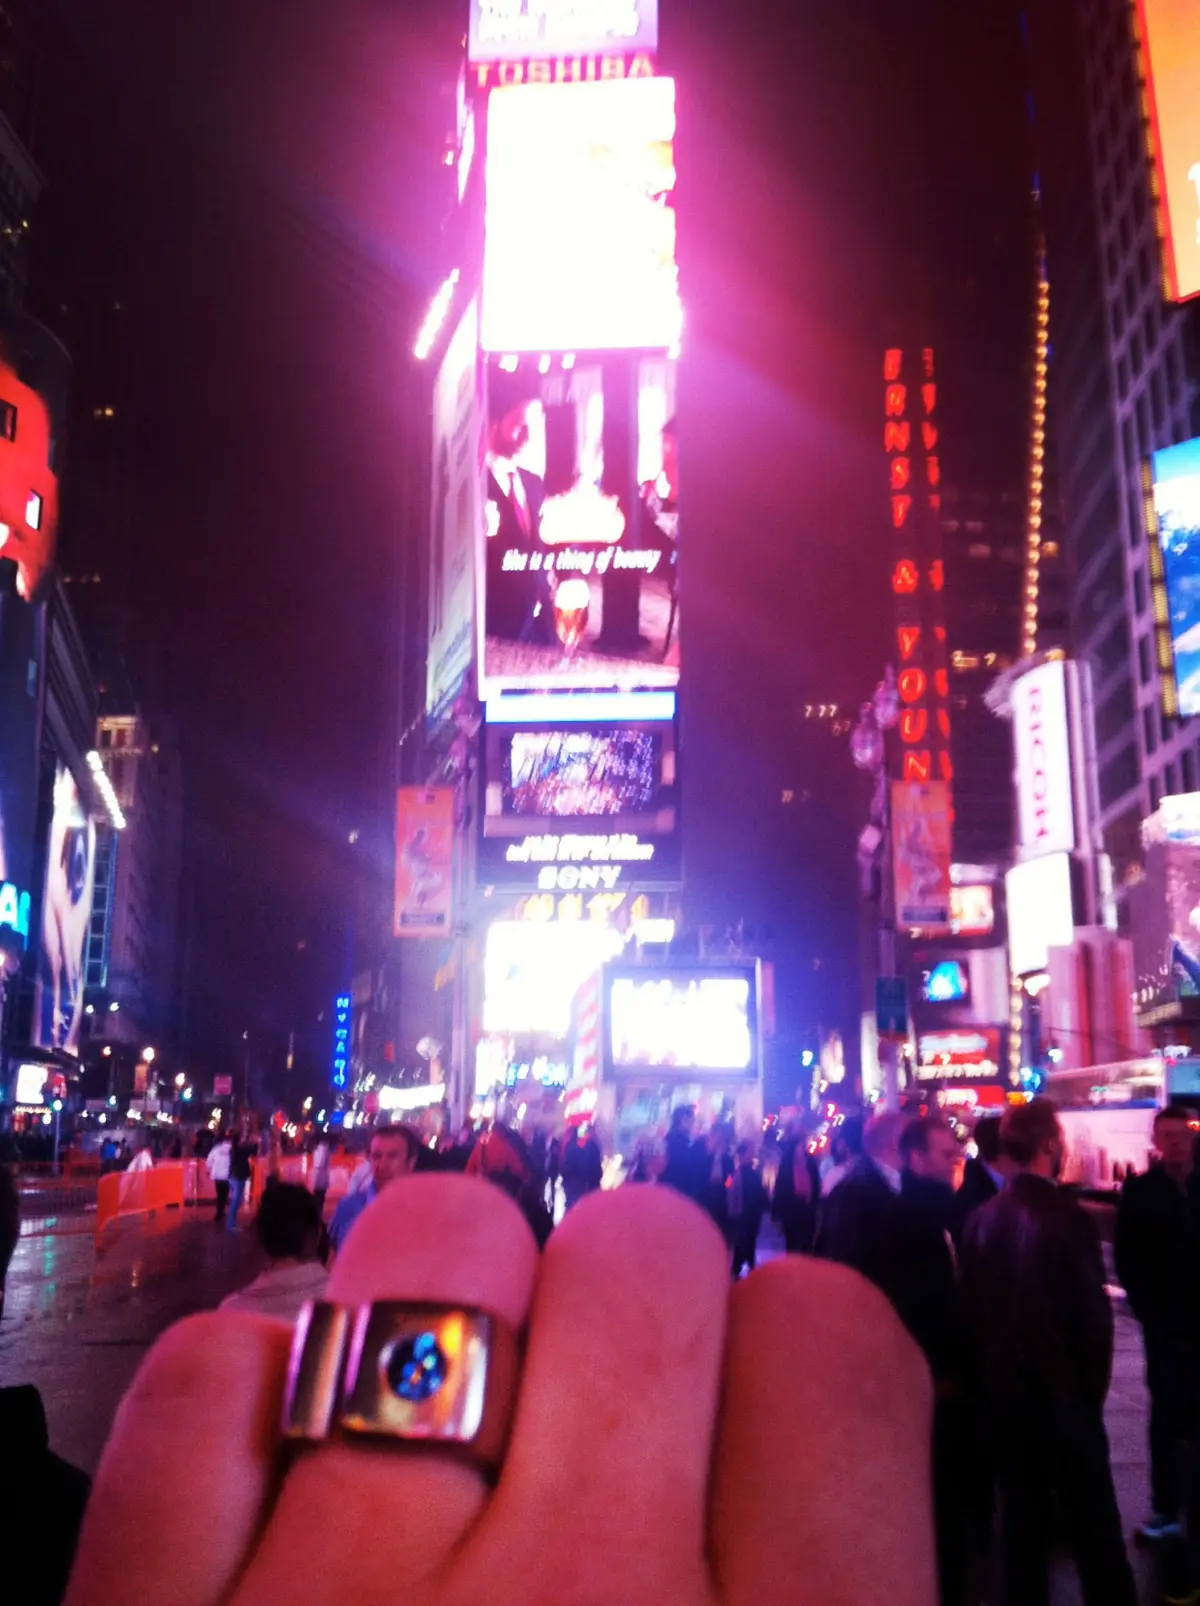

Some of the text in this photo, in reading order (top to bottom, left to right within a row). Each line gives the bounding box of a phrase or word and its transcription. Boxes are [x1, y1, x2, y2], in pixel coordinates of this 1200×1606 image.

[471, 53, 654, 88] TOSHIBA
[594, 546, 615, 575] of
[898, 626, 932, 782] YOUN
[538, 865, 622, 889] SONY
